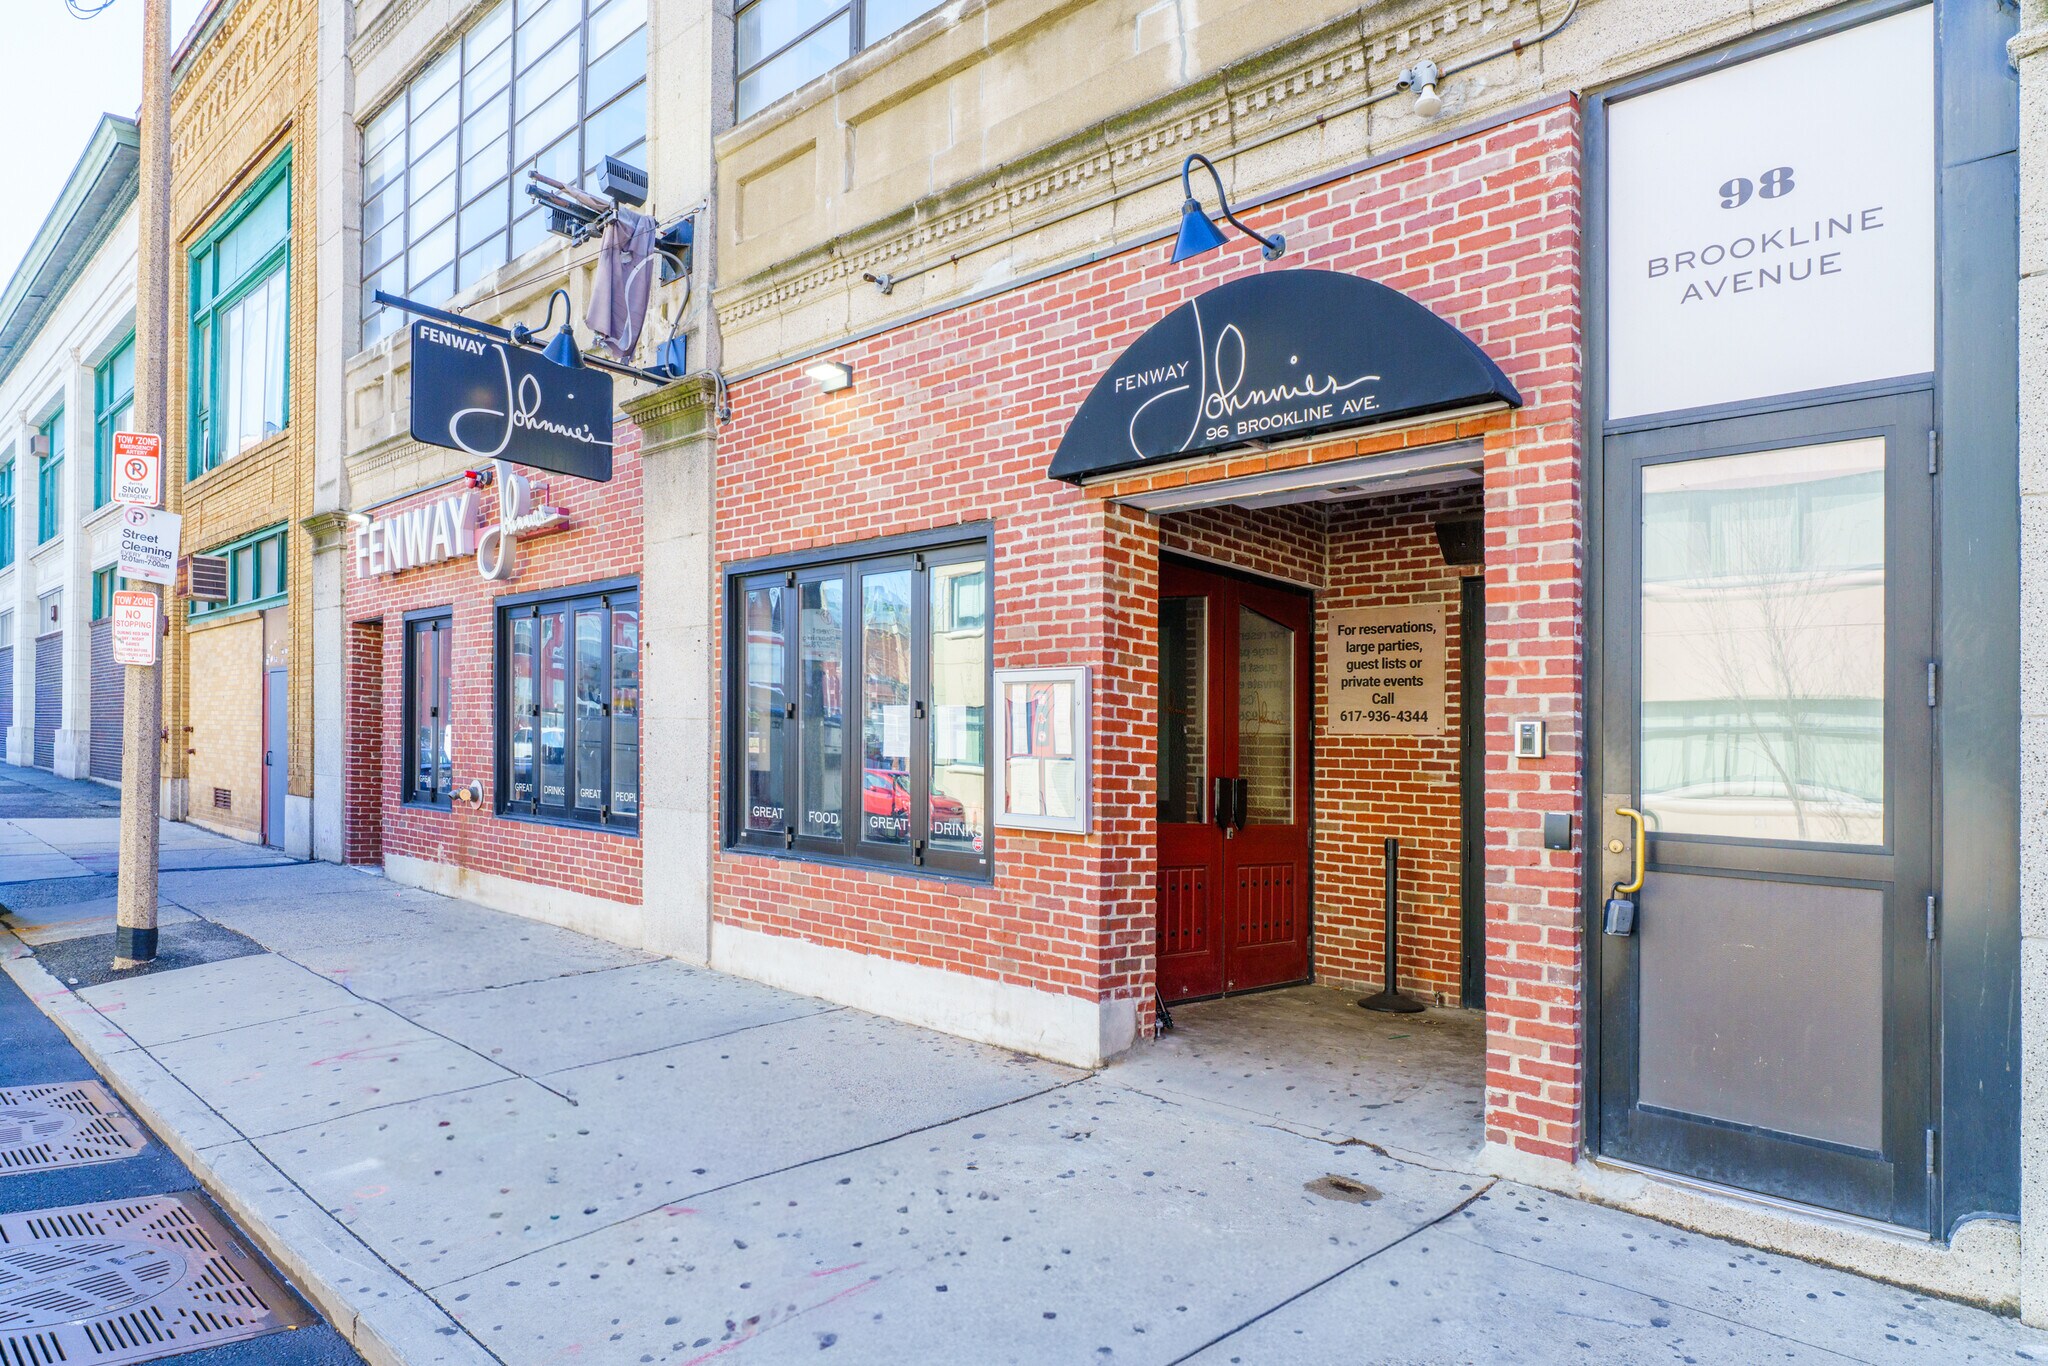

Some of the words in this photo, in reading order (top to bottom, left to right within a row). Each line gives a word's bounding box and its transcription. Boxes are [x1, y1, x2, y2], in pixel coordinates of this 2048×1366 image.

[1719, 166, 1795, 209] 98
[1648, 206, 1884, 278] BROOKLINE
[1680, 252, 1842, 304] AVENUE
[420, 325, 487, 355] FENWAY
[1115, 360, 1190, 393] FENWAY
[1206, 424, 1229, 440] 96
[1237, 404, 1333, 435] BROOKLINE
[1341, 395, 1380, 415] AVE.
[117, 435, 133, 444] TOW
[137, 437, 158, 446] ZONE
[120, 443, 154, 451] EMERGENCY
[118, 492, 151, 500] EMERGENCY
[122, 485, 149, 494] SNOW
[122, 528, 159, 544] Street
[356, 491, 478, 579] FENWAY
[121, 540, 172, 559] Cleaning
[116, 596, 132, 605] TOW
[133, 597, 154, 606] ZONE
[125, 610, 141, 619] NO
[116, 620, 151, 629] STOPPING
[1337, 624, 1357, 636] For
[1358, 621, 1437, 635] reservations,
[1345, 641, 1375, 655] large
[1378, 639, 1423, 655] parties,
[1346, 658, 1379, 672] guest
[1381, 657, 1407, 670] lists
[1409, 659, 1422, 669] or
[1341, 676, 1381, 690] private
[1383, 676, 1424, 687] events
[1371, 692, 1395, 705] Call
[1340, 710, 1428, 722] 617-936-4344
[514, 782, 533, 793] GREAT
[543, 785, 565, 797] DRINKS
[580, 788, 602, 799] GREAT
[615, 791, 637, 803] PEOPL
[752, 805, 784, 819] GREAT
[808, 811, 839, 824] FOOD
[869, 816, 908, 831] GREAT
[934, 821, 984, 838] DRINKS
